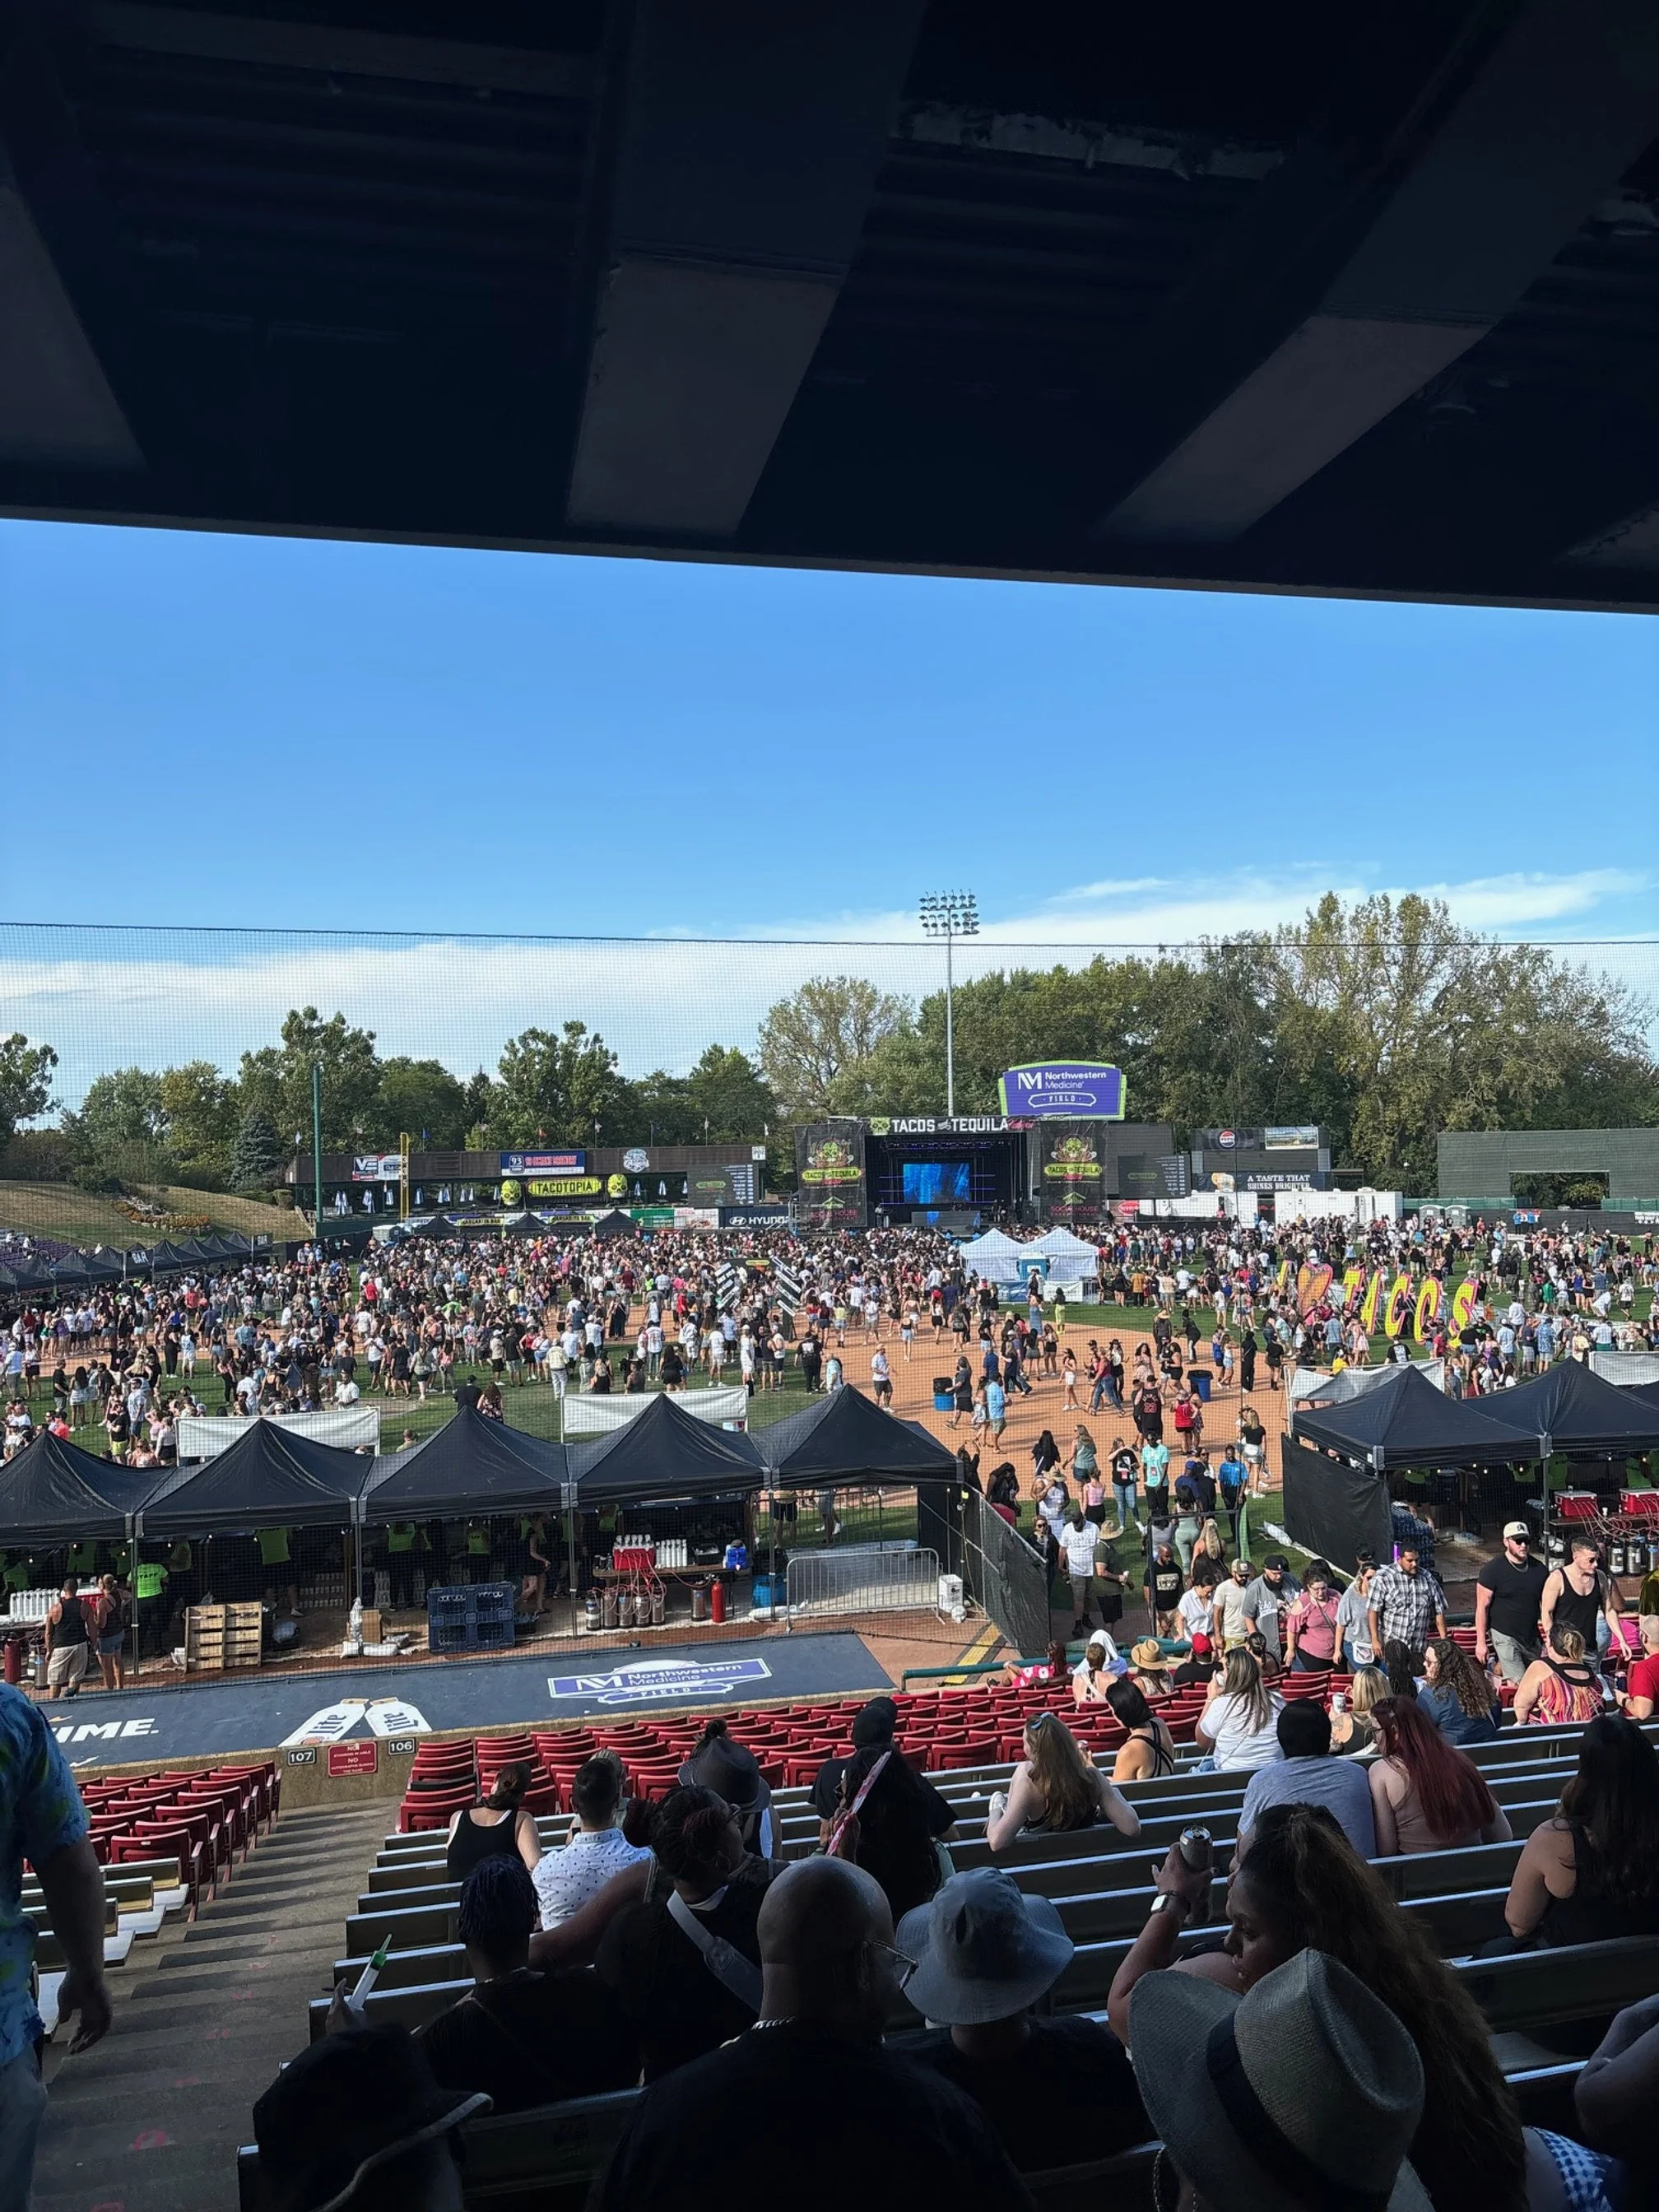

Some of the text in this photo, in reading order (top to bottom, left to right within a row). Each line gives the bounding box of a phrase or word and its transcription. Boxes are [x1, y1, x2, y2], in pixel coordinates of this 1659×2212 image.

[1044, 1071, 1107, 1080] Northwestern
[1048, 1094, 1076, 1103] FIELD
[891, 1119, 936, 1132] TACOS
[950, 1118, 1008, 1132] TEQUILA
[511, 1157, 523, 1165] 93
[831, 1169, 857, 1178] TEQUILA
[1256, 1173, 1284, 1182] TASTE
[1285, 1173, 1311, 1182] THAT
[537, 1180, 592, 1194] TACOTOPIA
[749, 1216, 789, 1224] HYUND
[257, 1235, 267, 1246] BAR
[131, 1252, 149, 1264] BAR
[1342, 1266, 1480, 1349] TACOS
[627, 1664, 742, 1680] Northwestern
[629, 1674, 700, 1686] Medicine
[640, 1688, 691, 1698] FIELD
[305, 1714, 347, 1734] Lite
[383, 1712, 419, 1732] Lite
[51, 1717, 160, 1744] IME.
[390, 1740, 412, 1752] 106
[290, 1751, 313, 1763] 107
